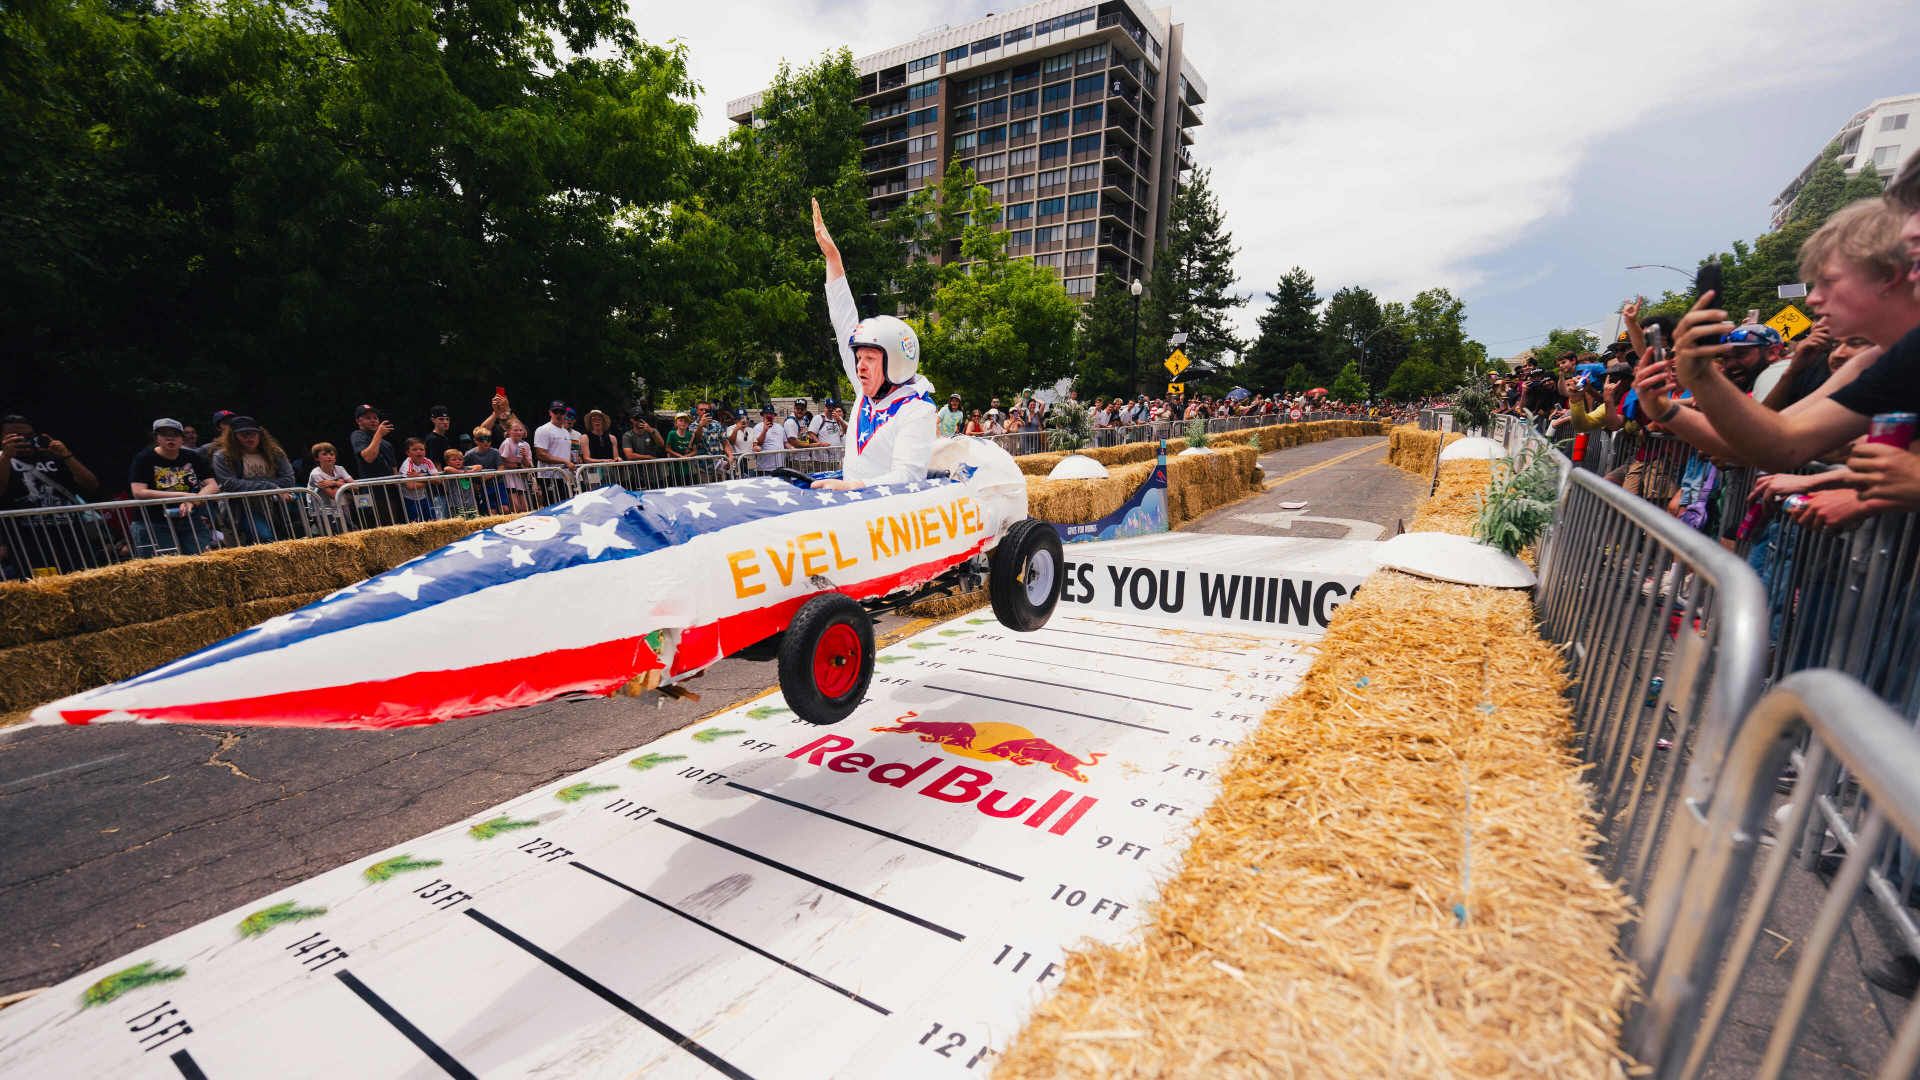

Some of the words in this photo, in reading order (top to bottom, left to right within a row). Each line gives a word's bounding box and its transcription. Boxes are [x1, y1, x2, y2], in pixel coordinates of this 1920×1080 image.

[726, 531, 858, 599] EVEL
[866, 496, 984, 561] KNIEVEL
[1107, 566, 1185, 613] YOU
[1200, 572, 1361, 629] WIIING
[1264, 674, 1283, 682] FT
[1249, 694, 1270, 702] FT
[1230, 714, 1253, 723] FT
[750, 742, 777, 753] FT
[1189, 735, 1202, 743] 6
[1208, 738, 1233, 746] FT
[676, 767, 705, 779] 10
[697, 773, 728, 785] FT
[1162, 764, 1180, 772] 7
[1184, 768, 1210, 780] FT
[784, 734, 944, 789] Red
[918, 765, 1098, 836] Bull
[603, 799, 634, 813] 11
[624, 806, 657, 821] FT
[1153, 803, 1184, 816] FT
[517, 837, 553, 854] 12
[537, 847, 575, 862] FT
[1096, 835, 1113, 849] 9
[1117, 842, 1151, 861] FT
[413, 878, 453, 899] 13
[432, 891, 473, 910] FT
[1050, 884, 1087, 907] 10
[1091, 898, 1129, 921] FT
[285, 931, 331, 958] 14
[301, 946, 350, 972] FT
[992, 944, 1033, 974] 11
[1036, 962, 1057, 983] F
[125, 1000, 179, 1033] 15
[138, 1019, 194, 1053] FT
[918, 1022, 967, 1059] 12
